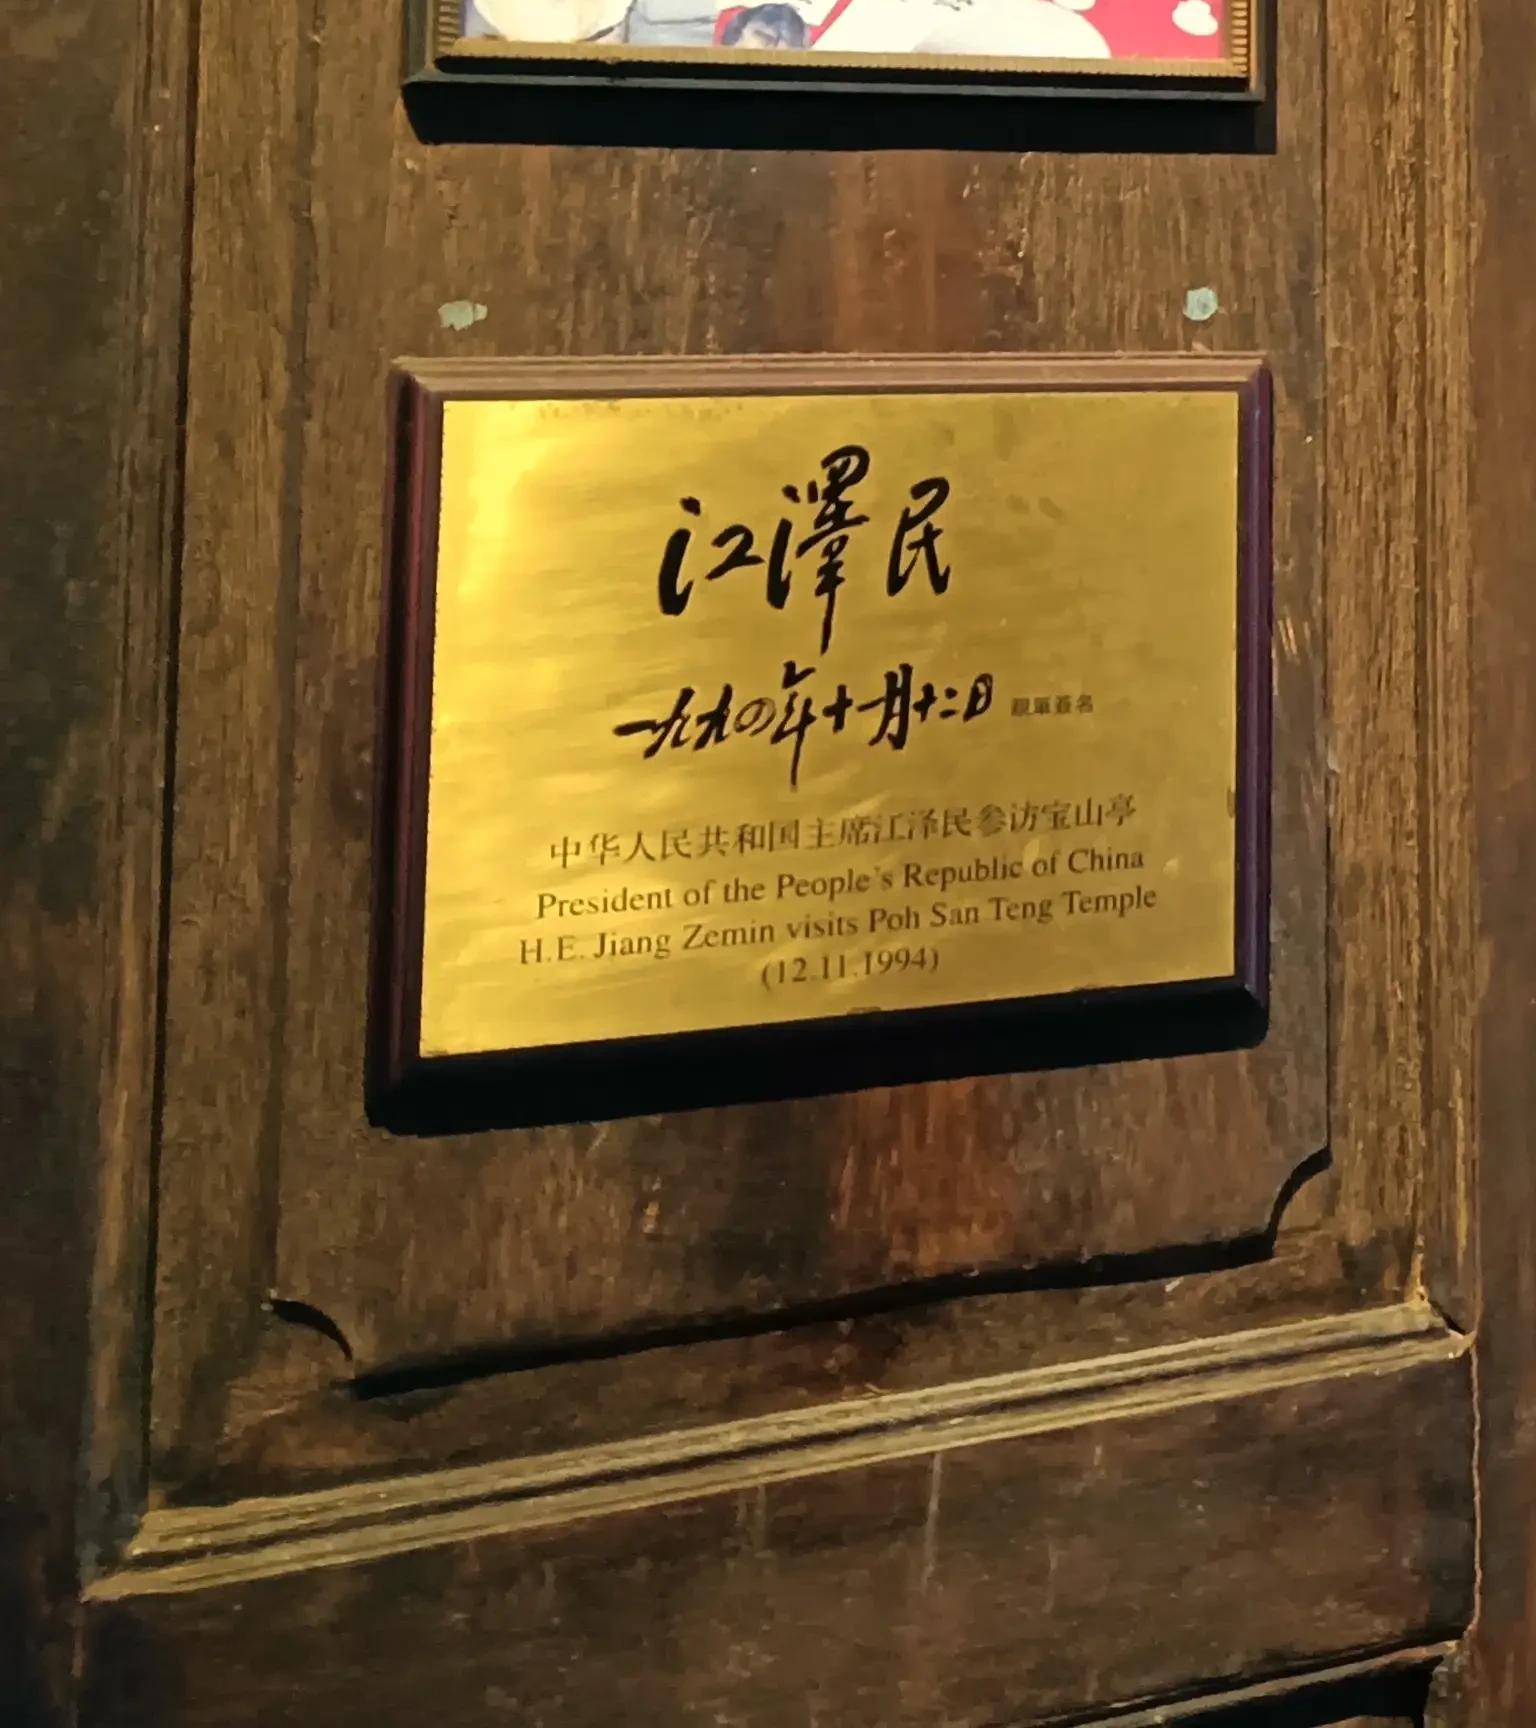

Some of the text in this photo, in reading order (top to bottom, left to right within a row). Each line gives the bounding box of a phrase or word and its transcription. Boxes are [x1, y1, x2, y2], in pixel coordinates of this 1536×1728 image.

[536, 846, 1144, 919] President of the People's Republic of China
[520, 885, 1157, 964] H.E. Jiang Zemin visits Poh San Teng Temple
[761, 945, 939, 991] (12.11.1994)
